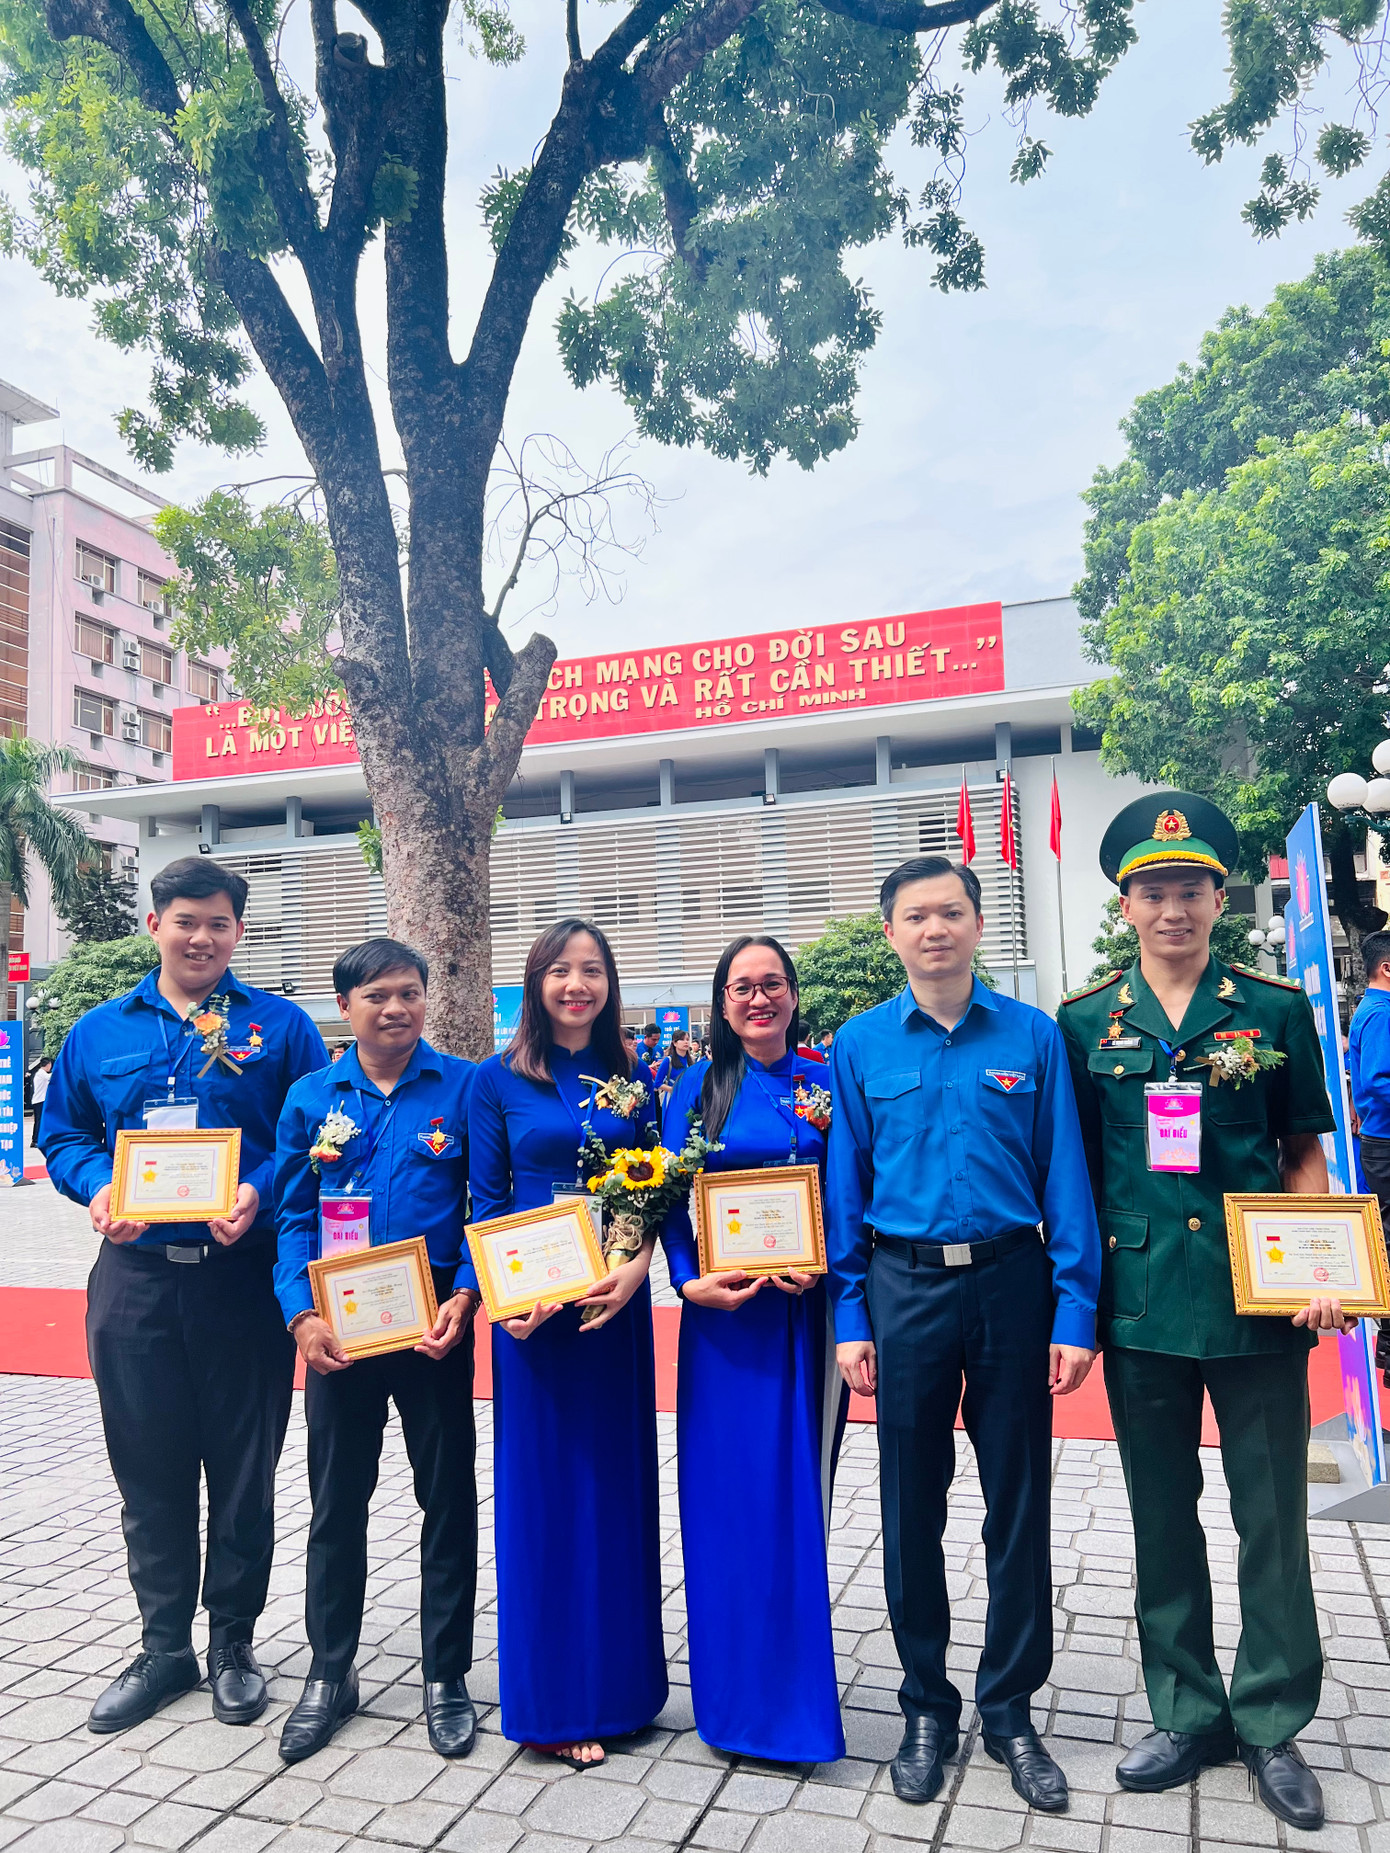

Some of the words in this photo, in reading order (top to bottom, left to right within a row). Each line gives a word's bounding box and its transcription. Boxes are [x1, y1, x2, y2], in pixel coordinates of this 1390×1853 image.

[596, 652, 682, 684] MẠNG
[692, 643, 755, 672] CHO
[768, 628, 825, 663] ĐỜI
[840, 621, 906, 653] SAU
[535, 688, 629, 721] TRỌNG
[640, 678, 679, 708] VÀ
[694, 667, 756, 702] RẤT
[769, 658, 835, 693] CẦN
[695, 699, 732, 719] HỒ
[740, 695, 786, 713] CHÍ
[799, 688, 866, 707] MINH
[206, 730, 237, 757] LÀ
